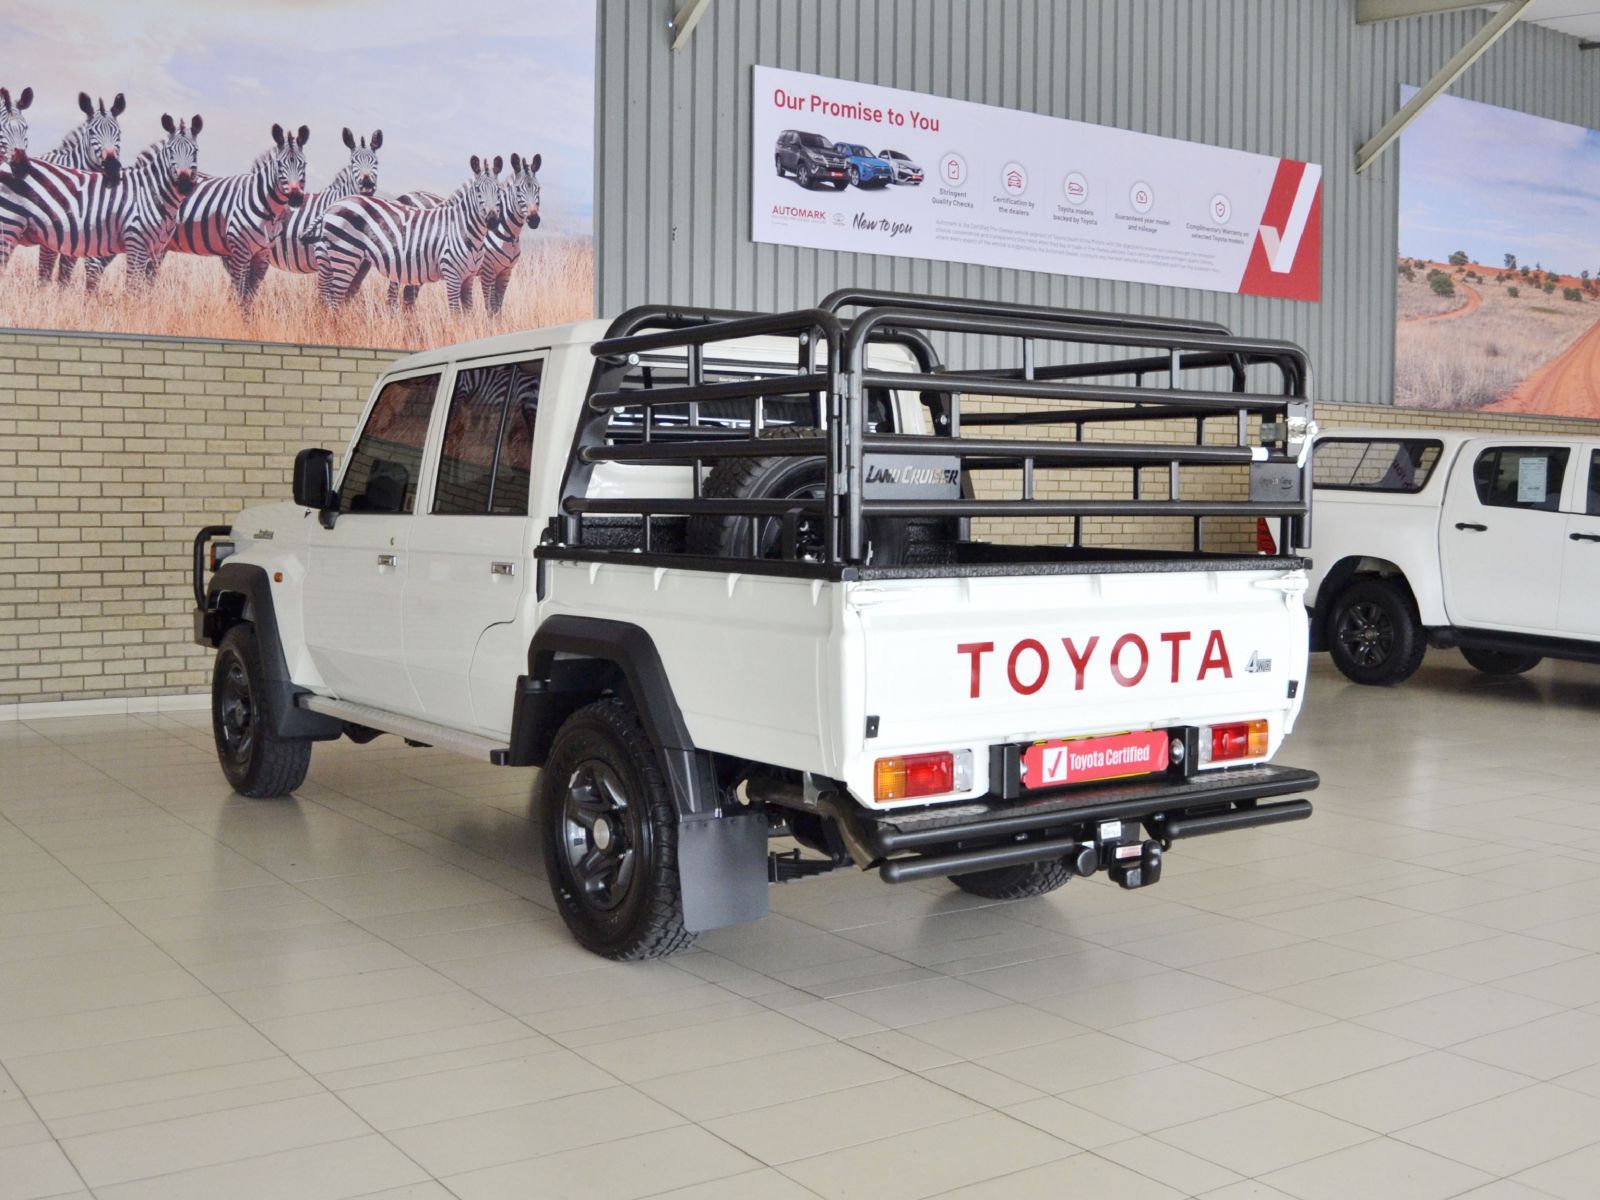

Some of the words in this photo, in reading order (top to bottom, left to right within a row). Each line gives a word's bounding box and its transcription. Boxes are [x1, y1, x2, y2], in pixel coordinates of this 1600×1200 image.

[773, 88, 805, 112] Our
[810, 94, 883, 123] Promise
[888, 108, 905, 127] to
[910, 110, 940, 132] You
[939, 188, 967, 199] Stringent
[931, 197, 952, 206] Quality
[953, 200, 974, 209] Checks
[993, 195, 1028, 207] Certification
[1028, 201, 1035, 209] by
[772, 205, 827, 220] AUTOMARK
[998, 206, 1008, 214] the
[1008, 207, 1030, 217] dealers
[1057, 204, 1075, 214] Toyota
[1075, 208, 1094, 216] models
[852, 212, 878, 231] New
[879, 218, 890, 232] to
[891, 222, 913, 238] you
[1053, 214, 1073, 223] backed
[1073, 216, 1080, 224] by
[1080, 217, 1098, 226] Toyota
[901, 465, 959, 486] CRUISER
[957, 629, 1233, 699] TOYOTA
[1069, 750, 1104, 772] Toyota
[1105, 744, 1150, 767] Certified
